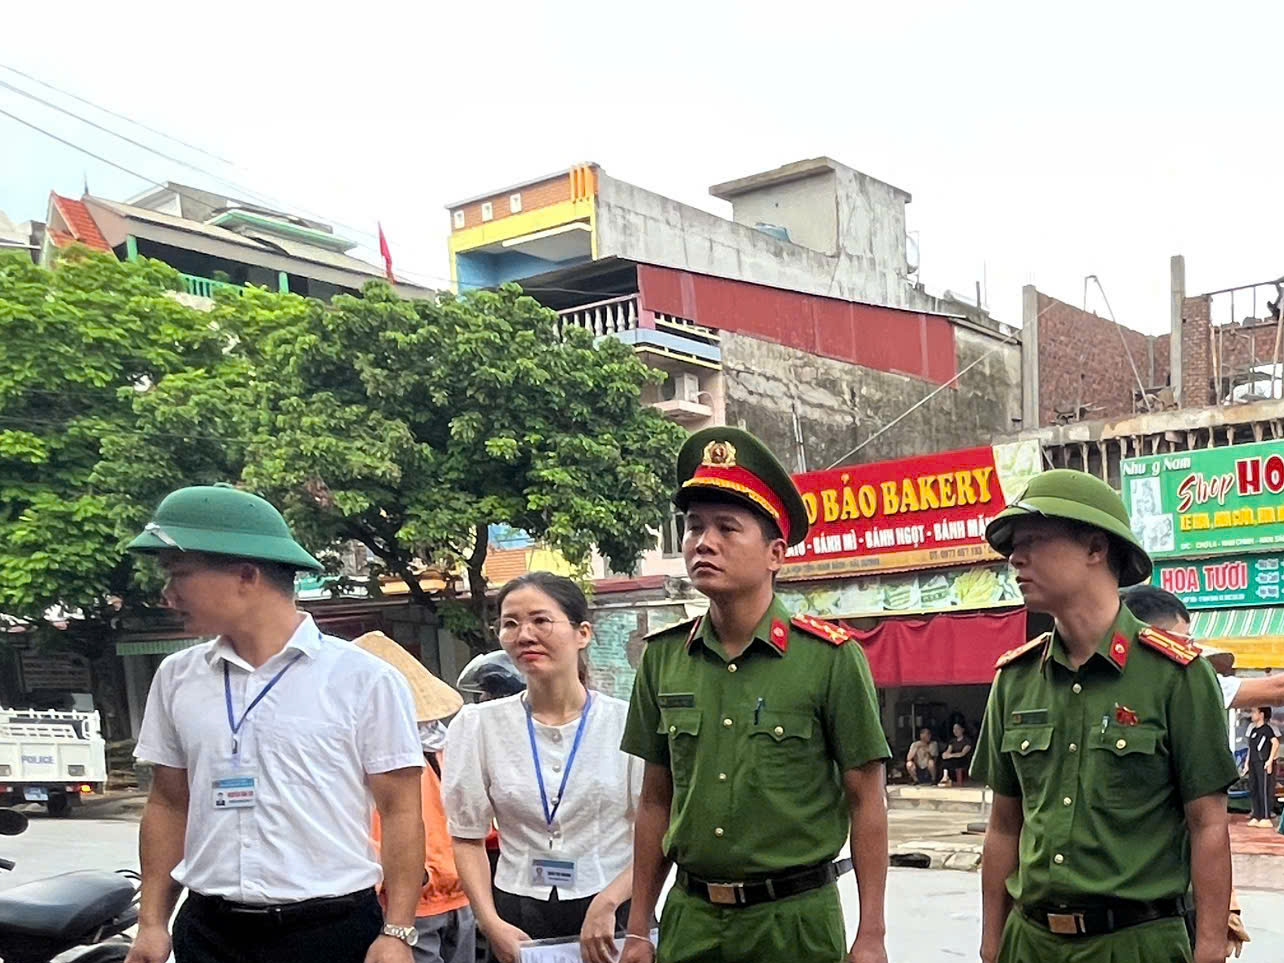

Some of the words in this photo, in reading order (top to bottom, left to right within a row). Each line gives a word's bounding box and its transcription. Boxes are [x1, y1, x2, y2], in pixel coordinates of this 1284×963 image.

[821, 473, 877, 522] BẢO
[880, 466, 994, 517] BAKERY
[1176, 472, 1235, 513] Shop
[1160, 567, 1200, 593] HOA
[1203, 561, 1249, 592] TƯƠI
[21, 754, 55, 765] POLICE
